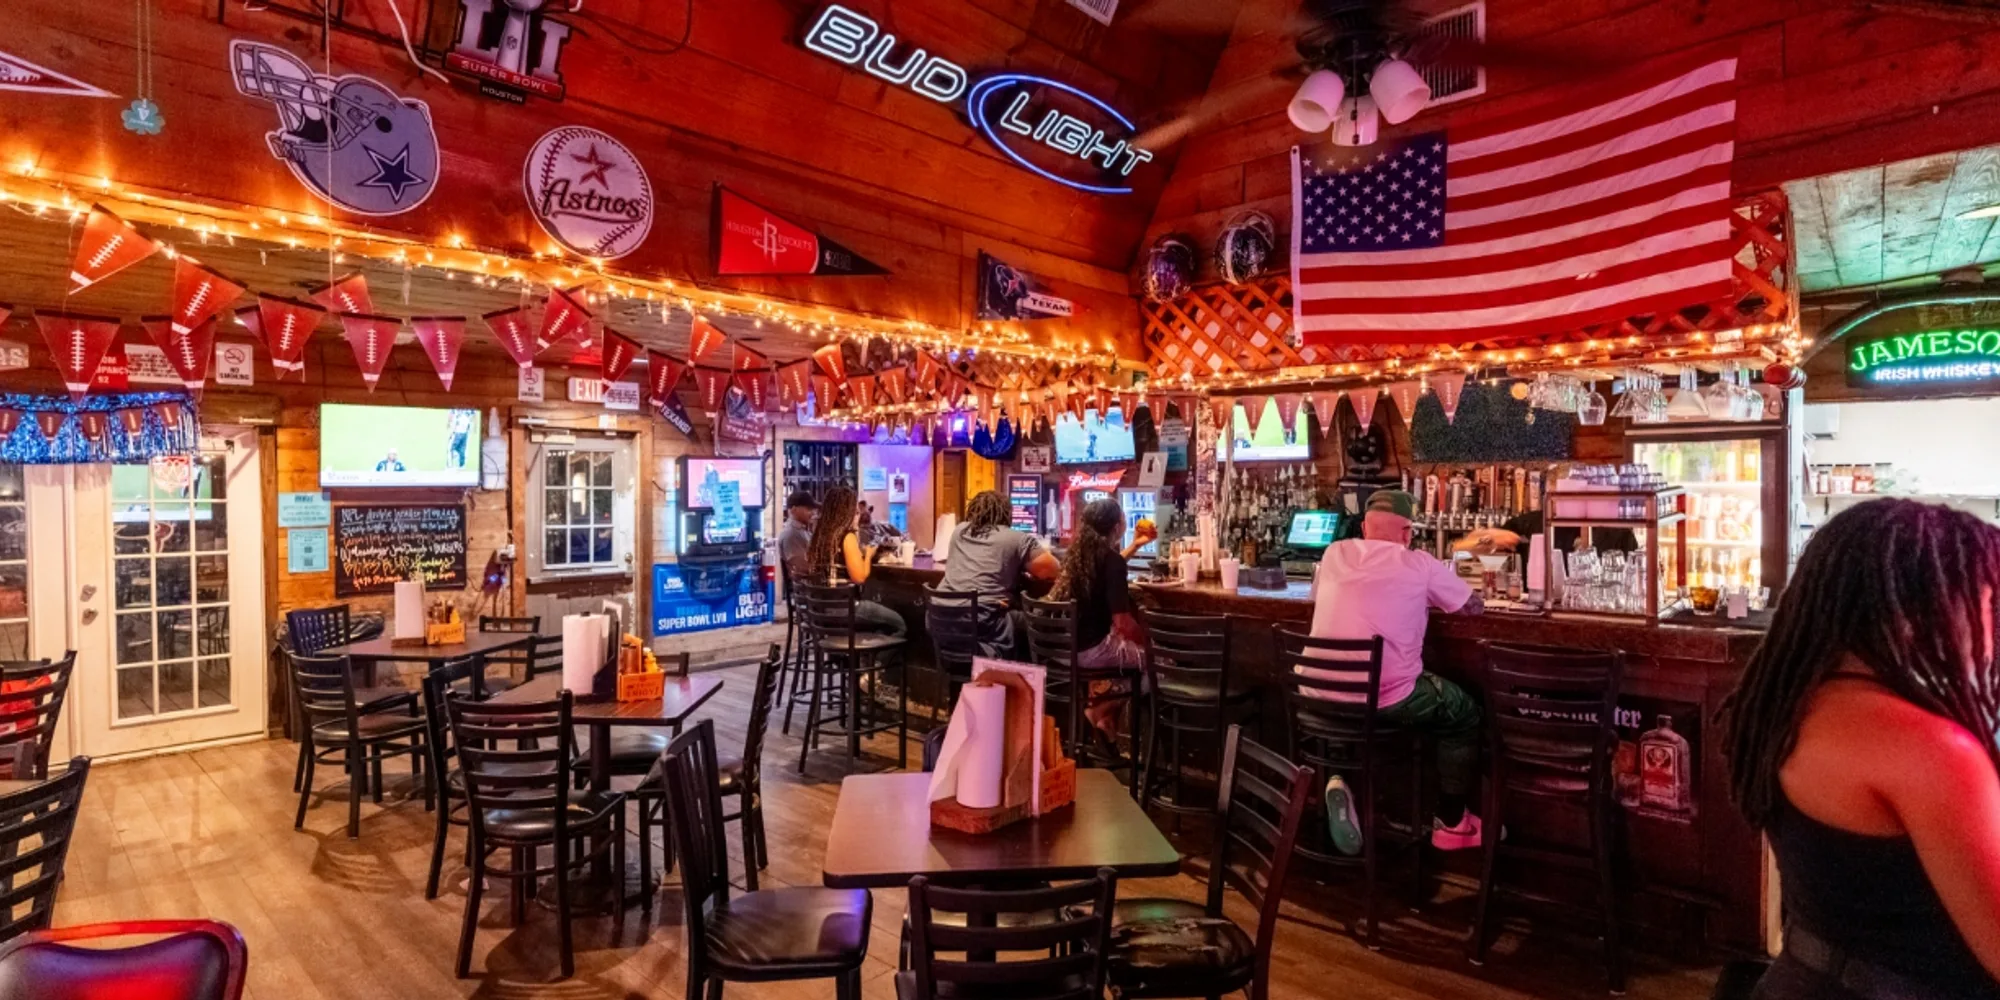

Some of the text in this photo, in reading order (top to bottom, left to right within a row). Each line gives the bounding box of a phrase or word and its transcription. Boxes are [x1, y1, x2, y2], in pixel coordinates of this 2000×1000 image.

[460, 60, 549, 93] SUPER BOWL
[481, 86, 523, 103] HOUSTON
[803, 3, 1153, 176] BUD LIGHT
[540, 178, 641, 219] Astros
[725, 220, 813, 251] HOUSTON ROCKETS
[1031, 297, 1073, 313] TEXANS
[1850, 330, 2000, 371] JAMESO
[219, 372, 250, 381] SMOKING
[1874, 362, 2000, 381] IRISH WHISKEY
[575, 377, 602, 400] EXIT
[1069, 474, 1121, 488] Budweiser
[739, 592, 765, 606] BUD
[735, 603, 768, 619] LIGHT
[658, 616, 686, 630] SUPER
[687, 613, 710, 627] BOWL
